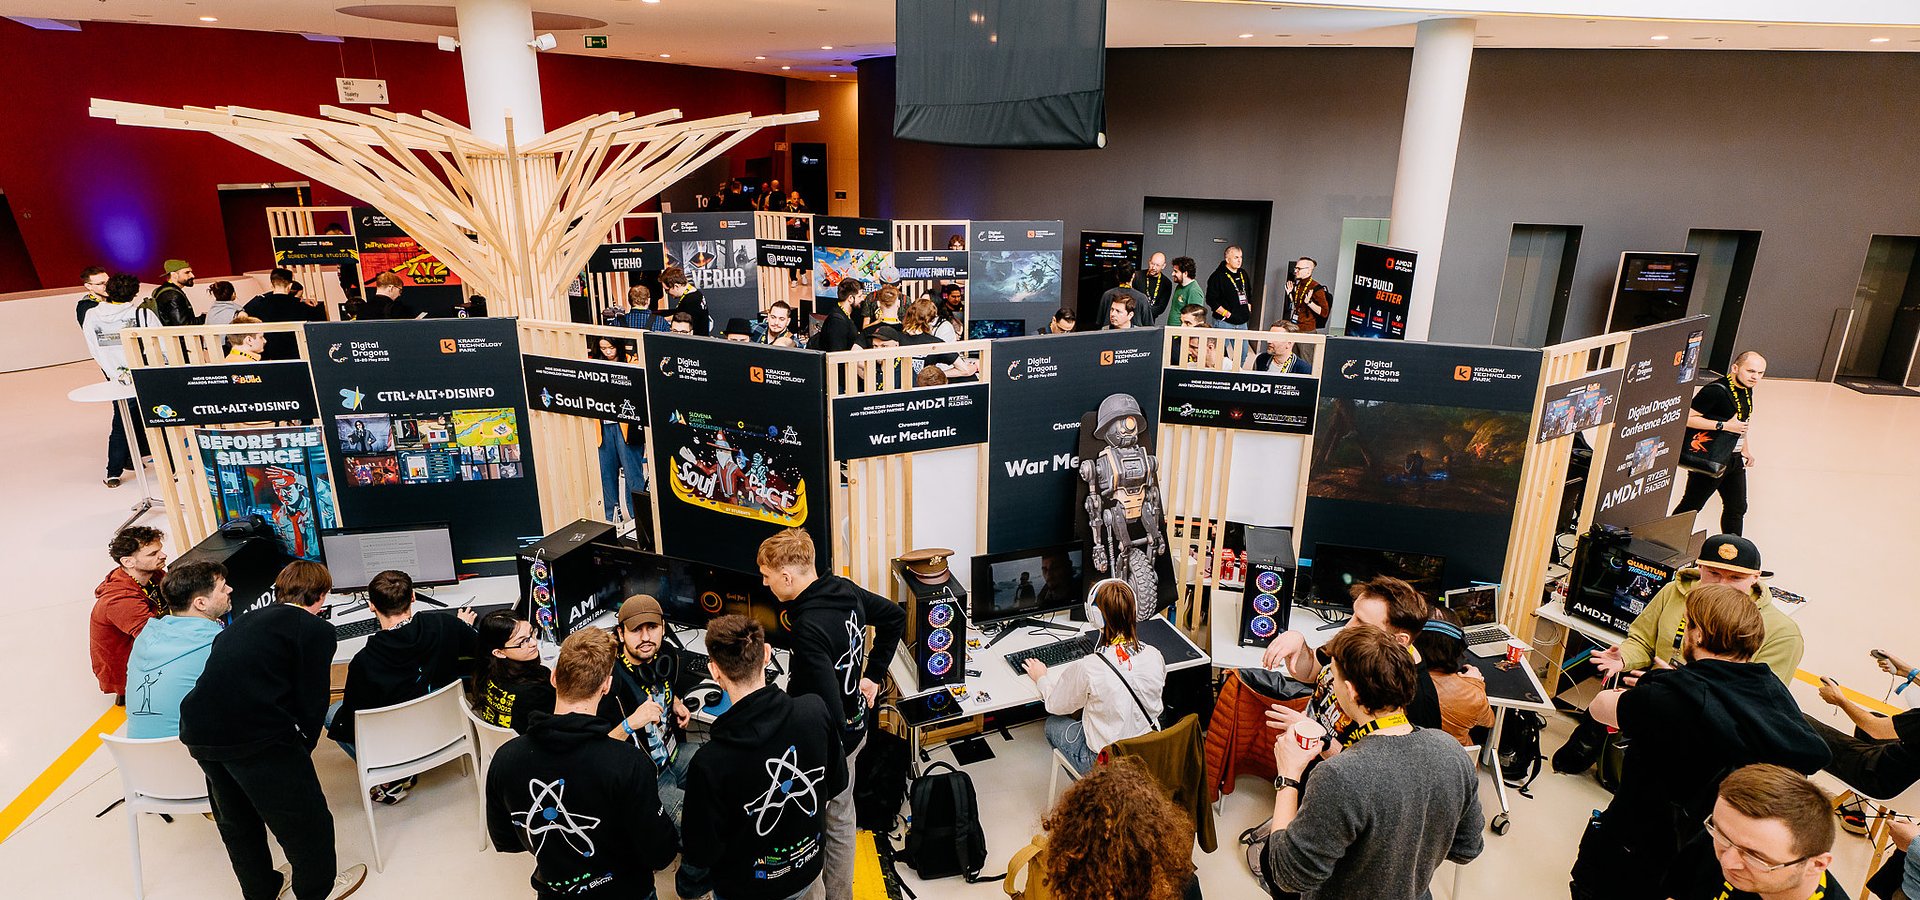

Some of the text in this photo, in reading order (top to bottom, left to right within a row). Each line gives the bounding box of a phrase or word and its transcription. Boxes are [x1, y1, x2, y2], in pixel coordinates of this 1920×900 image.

[611, 257, 642, 270] VERHO
[776, 255, 802, 263] REVULO
[690, 267, 746, 290] VERHO
[1354, 274, 1394, 292] LET'S BUILD
[1376, 290, 1402, 304] BETTER
[350, 342, 379, 350] Digital
[352, 350, 389, 358] Dragons
[677, 357, 699, 367] Digital
[1027, 356, 1051, 367] Digital
[1365, 360, 1393, 369] Digital
[577, 370, 599, 382] AMD
[677, 365, 707, 377] Dragons
[765, 368, 791, 376] KRAKOW
[1027, 365, 1058, 374] Dragons
[1364, 367, 1400, 377] Dragons
[1473, 372, 1522, 380] TECHNOLOGY
[765, 374, 806, 384] TECHNOLOGY
[377, 387, 495, 402] CTRL+ALT+DISINFO
[1232, 382, 1260, 393] AMD
[192, 401, 300, 415] CTRL+ALT+DISINFO
[555, 393, 617, 414] Soul Pact
[906, 399, 935, 412] AMD
[1628, 395, 1681, 421] Digital Dragons
[689, 411, 713, 420] SLOVENIA
[1621, 409, 1681, 439] Conference 2025
[198, 431, 320, 450] BEFORE THE
[869, 426, 957, 446] War Mechanic
[216, 449, 304, 466] SILENCE
[1005, 453, 1080, 478] War Me
[1646, 468, 1668, 483] RYZEN
[1644, 478, 1671, 495] RADEON
[1600, 484, 1632, 512] AMD
[1627, 559, 1667, 578] QUANTUM
[1628, 566, 1663, 581] THRESHOLD
[243, 591, 271, 614] MD
[1573, 602, 1601, 618] AMD
